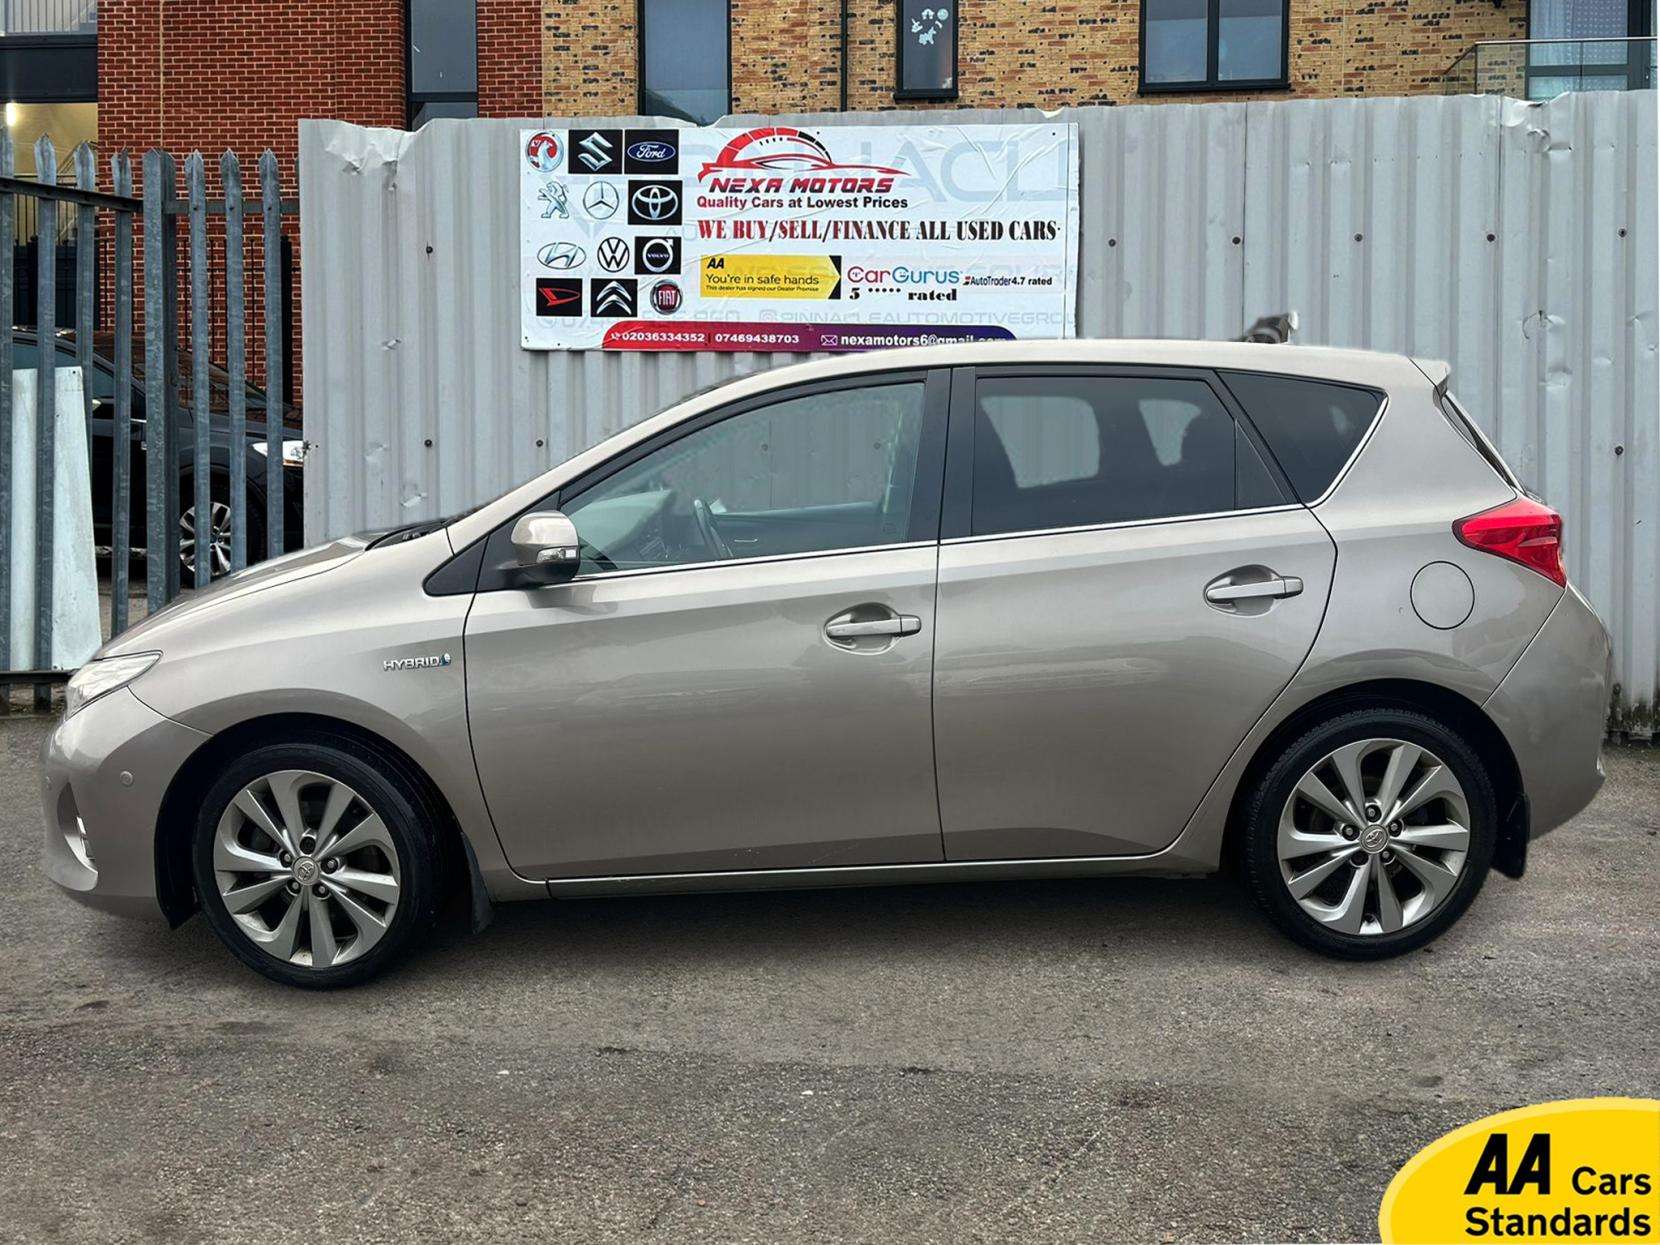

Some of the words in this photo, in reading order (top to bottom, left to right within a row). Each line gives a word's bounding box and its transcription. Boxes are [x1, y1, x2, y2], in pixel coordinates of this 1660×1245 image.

[636, 144, 666, 158] Ford
[709, 178, 783, 193] NEXA
[789, 178, 894, 193] MOTORS
[697, 196, 746, 209] Quality
[752, 196, 784, 208] Cars
[788, 197, 802, 208] at
[807, 196, 858, 208] Lowest
[863, 196, 908, 208] Prices
[698, 220, 727, 240] WE
[733, 220, 911, 243] BUY/SELL/FINANCE
[916, 220, 951, 240] ALL
[956, 220, 1004, 240] USED
[706, 258, 724, 269] AA
[706, 274, 741, 284] You're
[744, 274, 754, 284] in
[757, 274, 781, 284] safe
[784, 275, 820, 285] hands
[847, 266, 960, 284] CarGurus
[971, 276, 1011, 286] AutoTrader
[1028, 276, 1053, 286] rated
[658, 290, 676, 305] FIAT
[850, 287, 861, 300] 5
[908, 289, 957, 301] rated
[622, 332, 705, 343] 02036334352
[715, 333, 800, 344] 07469438703
[383, 656, 440, 671] HYBRID
